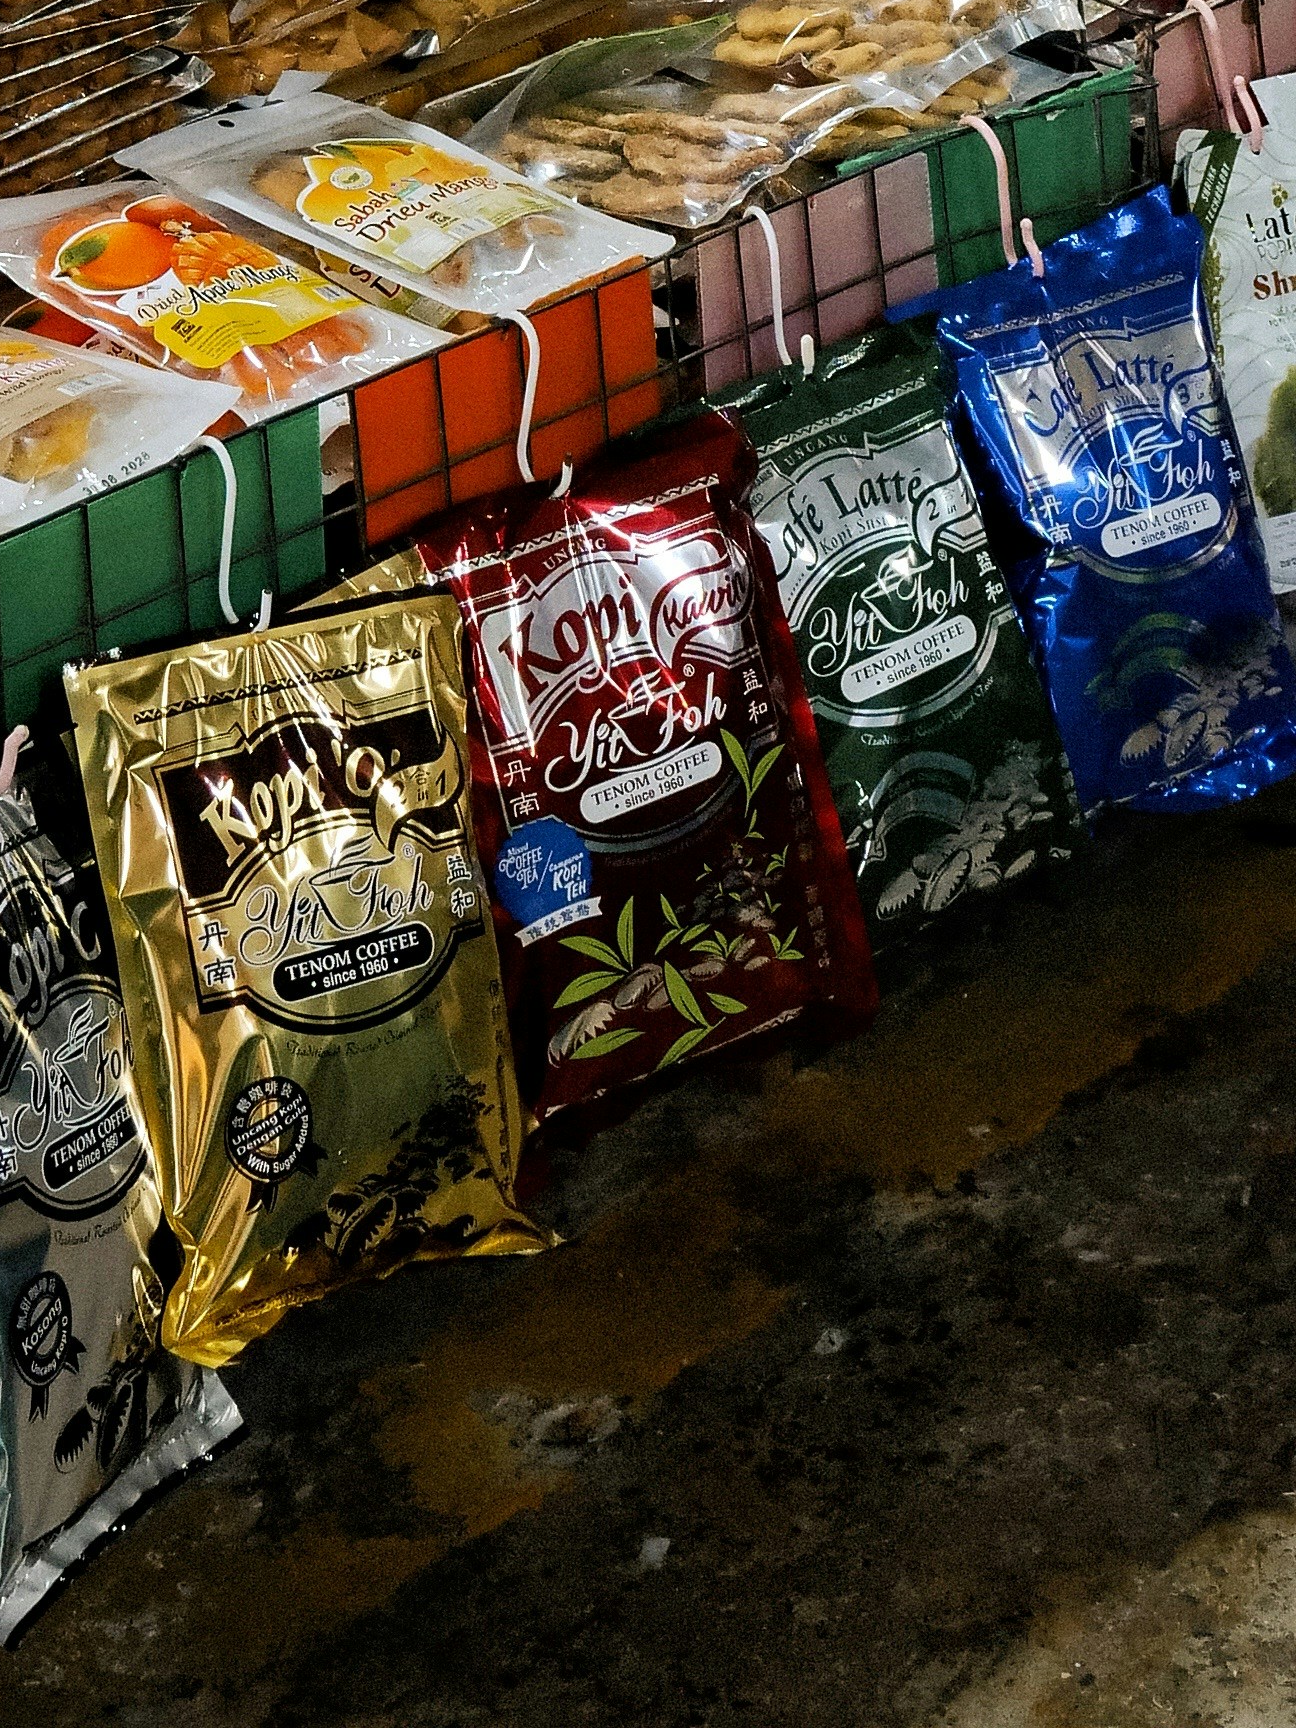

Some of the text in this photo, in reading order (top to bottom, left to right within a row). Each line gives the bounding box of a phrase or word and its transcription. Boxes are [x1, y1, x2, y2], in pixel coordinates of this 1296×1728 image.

[332, 190, 396, 237] Sabah
[135, 273, 242, 326] Dried Apple
[835, 459, 925, 521] Latté
[1109, 496, 1211, 541] TENOM COFFEE
[1139, 517, 1193, 546] since 1960
[906, 563, 972, 628] Foh
[497, 574, 642, 714] Kopi
[850, 621, 966, 686] TENOM COFFEE
[886, 647, 945, 687] since 1960
[741, 668, 771, 724] 益和
[543, 715, 628, 795] Yit
[588, 747, 711, 808] TENOM COFFEE
[200, 748, 324, 868] Kopi
[502, 757, 541, 818] 丹南
[623, 774, 686, 811] since 1960
[238, 854, 434, 966] Yit Foh
[447, 856, 474, 917] 益和
[199, 921, 236, 987] 丹南
[285, 930, 420, 982] TENOM COFFEE
[322, 957, 389, 989] since 1960
[231, 1094, 303, 1146] Uncang Kopi
[236, 1105, 307, 1156] Dengan Gula
[246, 1114, 309, 1174] With Sugar Added
[51, 1133, 98, 1169] TENOM
[75, 1151, 102, 1173] since
[21, 1297, 62, 1356] Kosong
